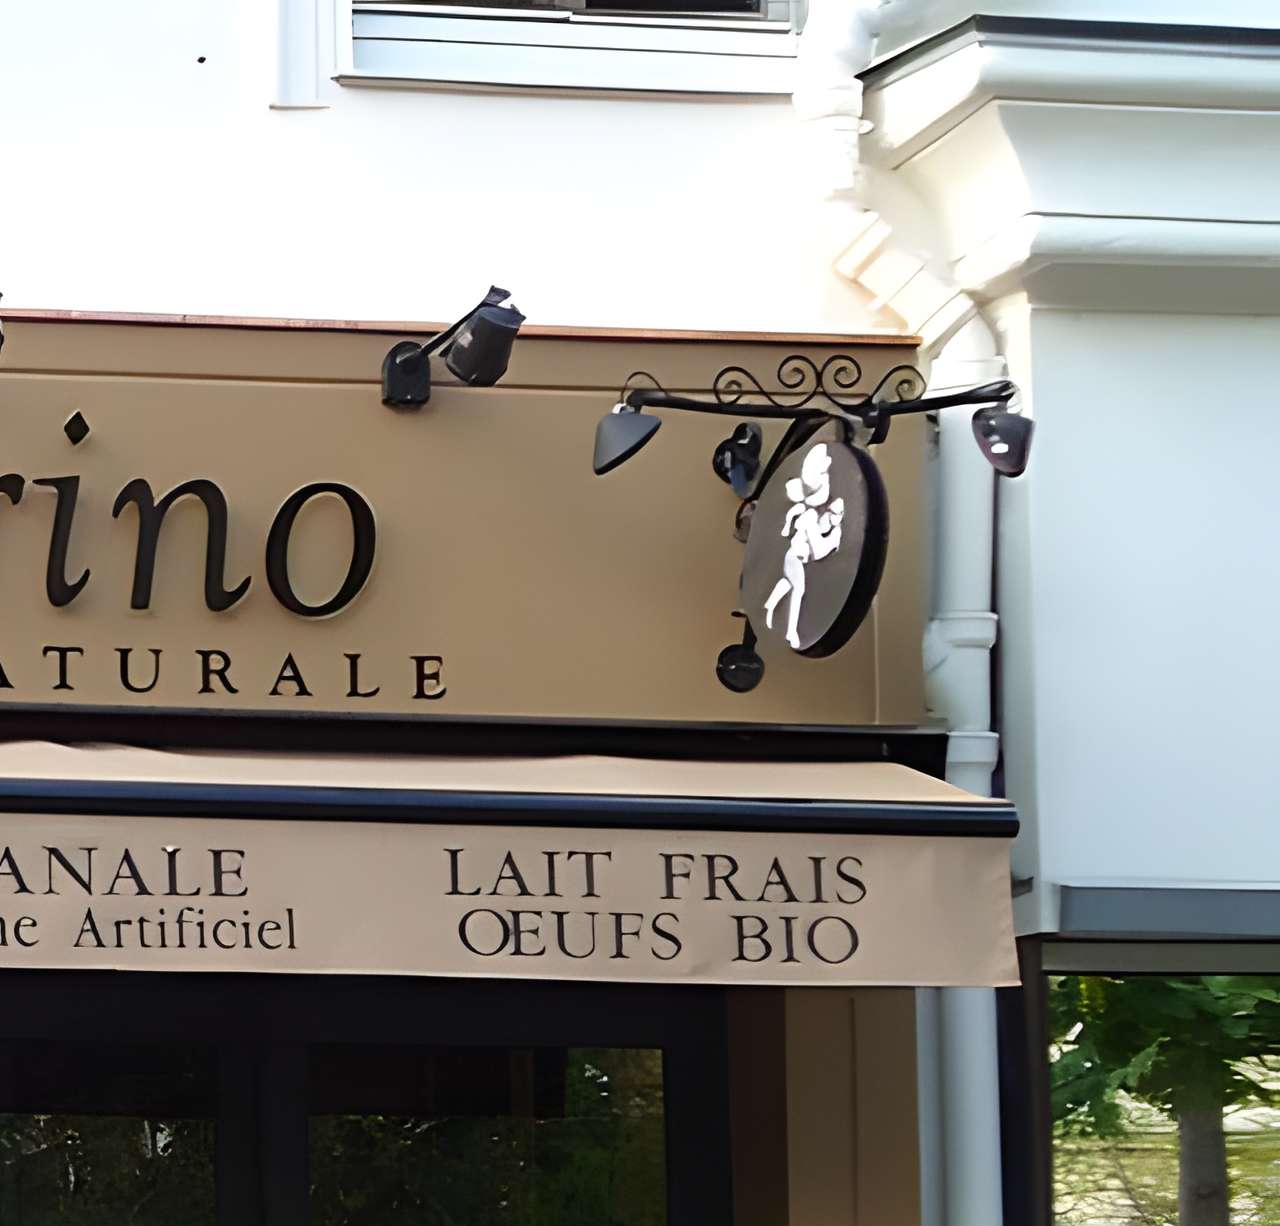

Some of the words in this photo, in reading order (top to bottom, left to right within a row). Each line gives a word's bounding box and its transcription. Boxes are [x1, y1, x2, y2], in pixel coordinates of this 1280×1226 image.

[443, 848, 612, 898] LAIT
[659, 852, 867, 905] FRAIS
[73, 904, 298, 952] Artificiel
[730, 914, 859, 964] BIO
